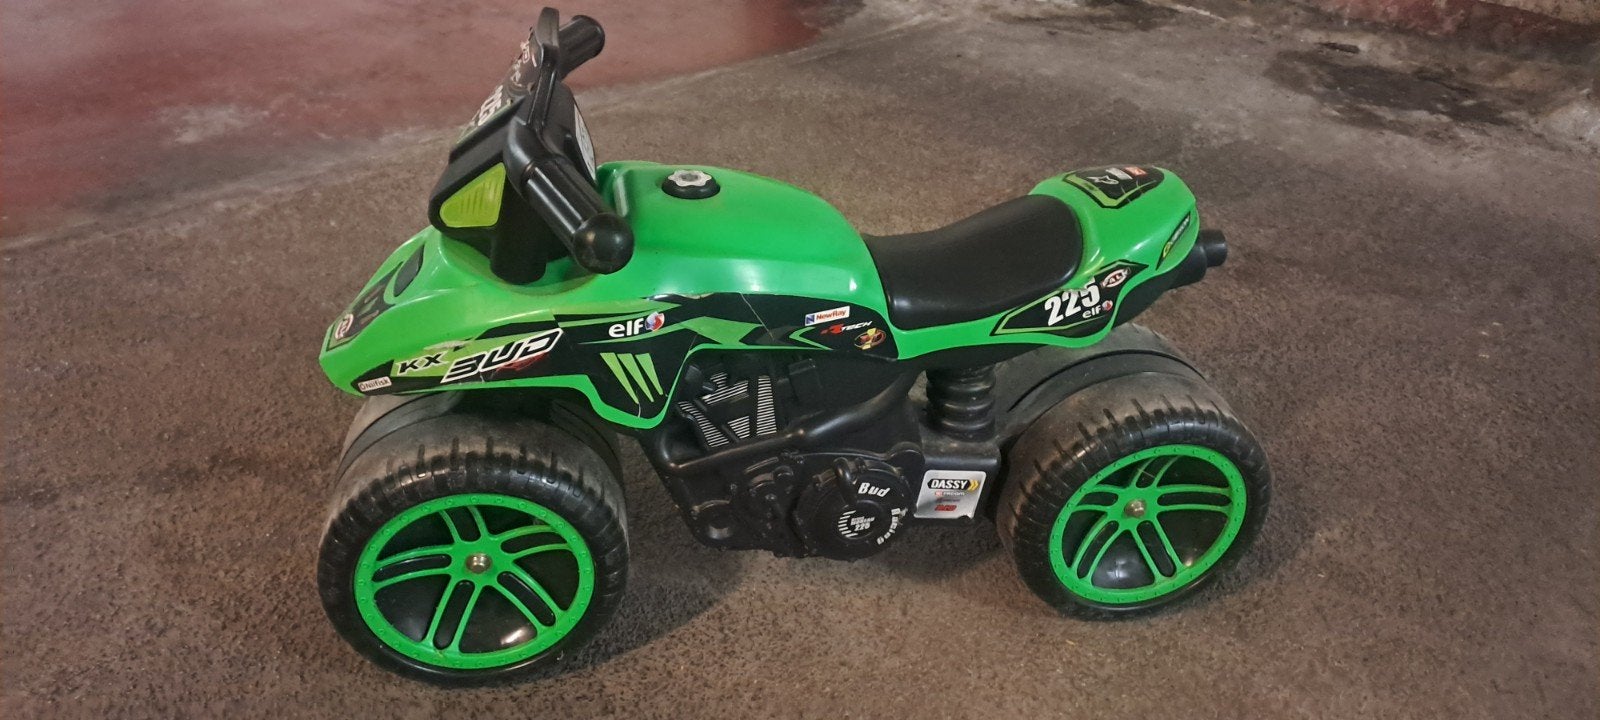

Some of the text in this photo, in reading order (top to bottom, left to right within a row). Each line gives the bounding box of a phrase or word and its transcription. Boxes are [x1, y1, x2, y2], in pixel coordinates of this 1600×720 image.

[1044, 276, 1101, 326] 225
[816, 309, 847, 321] NewRay
[1082, 304, 1102, 319] elf
[608, 317, 644, 337] elf
[397, 352, 444, 375] KX
[858, 482, 891, 498] Bud
[931, 479, 968, 490] DASSY
